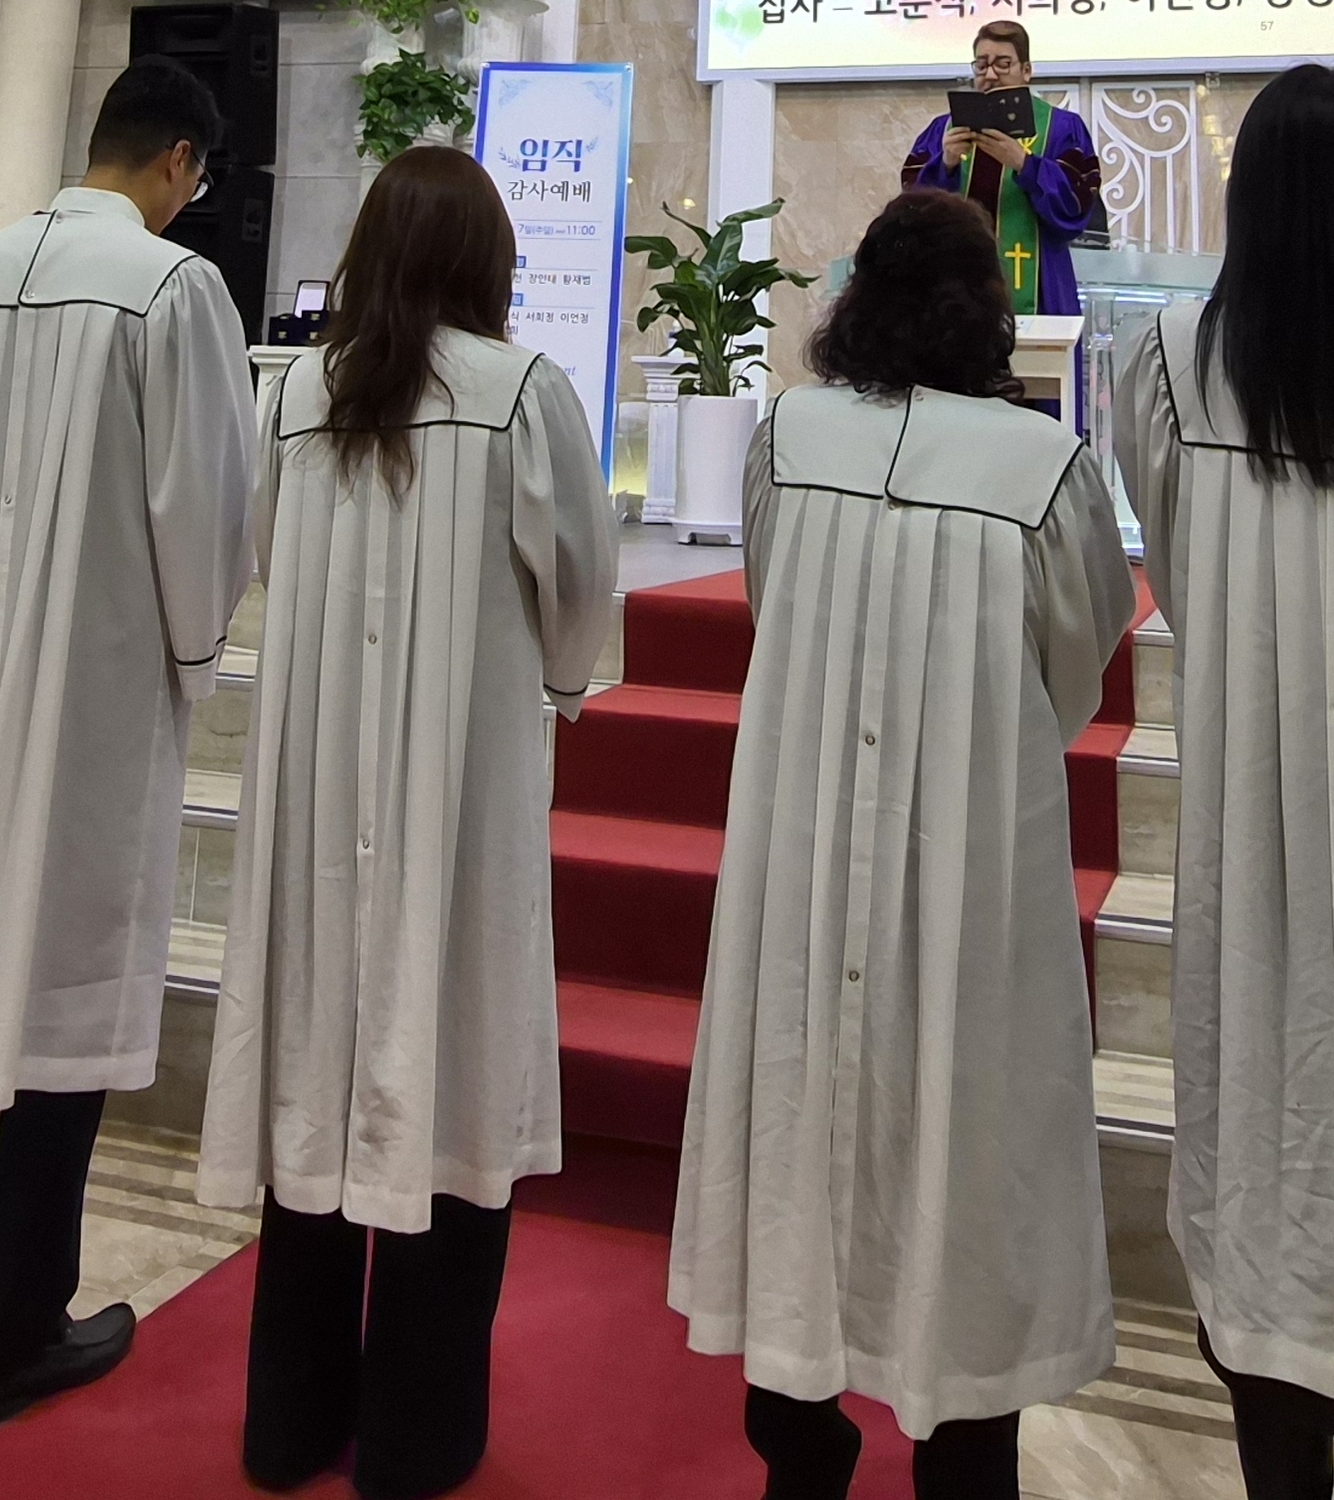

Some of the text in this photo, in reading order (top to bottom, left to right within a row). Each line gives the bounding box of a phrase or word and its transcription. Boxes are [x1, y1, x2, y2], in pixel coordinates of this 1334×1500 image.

[1260, 21, 1274, 31] 57
[520, 138, 583, 172] 임직
[507, 179, 590, 203] 감사예배
[566, 225, 596, 236] 11:00
